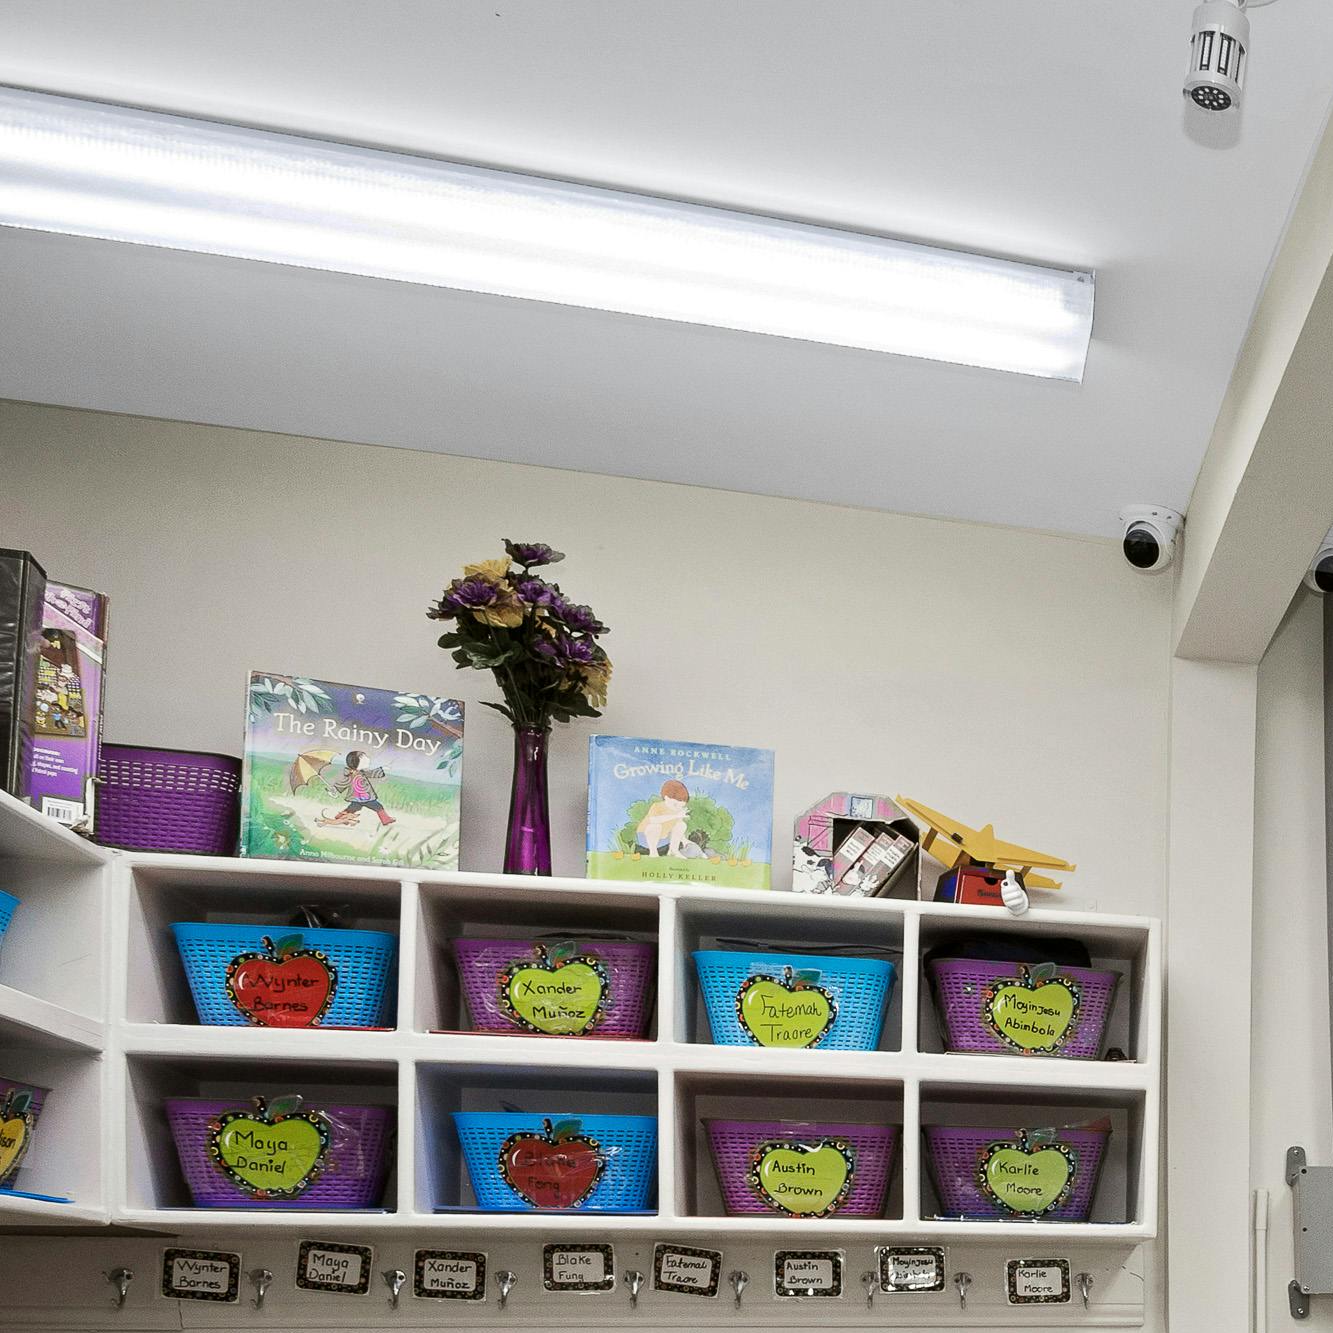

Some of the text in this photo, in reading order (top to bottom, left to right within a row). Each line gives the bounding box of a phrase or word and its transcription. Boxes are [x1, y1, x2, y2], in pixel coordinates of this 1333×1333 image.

[273, 712, 441, 757] The Rainy Day
[634, 747, 731, 761] ANNE ROCKWELL
[613, 760, 750, 790] Growing Like Me
[641, 871, 717, 881] HOLLY KELLER
[245, 976, 319, 993] Wynter
[522, 981, 581, 996] Xander
[250, 998, 308, 1012] Barnes
[532, 1005, 586, 1020] Muñoz
[760, 1023, 814, 1041] Traore
[1005, 1019, 1055, 1037] Abimbola
[235, 1130, 287, 1156] Maya
[231, 1156, 286, 1174] Daniel
[771, 1160, 815, 1176] Austin
[999, 1161, 1040, 1176] Karlie
[774, 1182, 823, 1197] Brown
[1006, 1182, 1042, 1196] Moore
[313, 1253, 349, 1274] Maya
[427, 1261, 472, 1273] Xander
[555, 1254, 591, 1266] Blake
[786, 1261, 819, 1272] Austin
[177, 1261, 227, 1275] Wynter
[309, 1268, 346, 1282] Daniel
[1018, 1268, 1047, 1279] Karlie
[175, 1275, 221, 1290] Barnes
[430, 1277, 470, 1290] Muñoz
[788, 1276, 823, 1285] Brown
[1024, 1284, 1053, 1294] Moore
